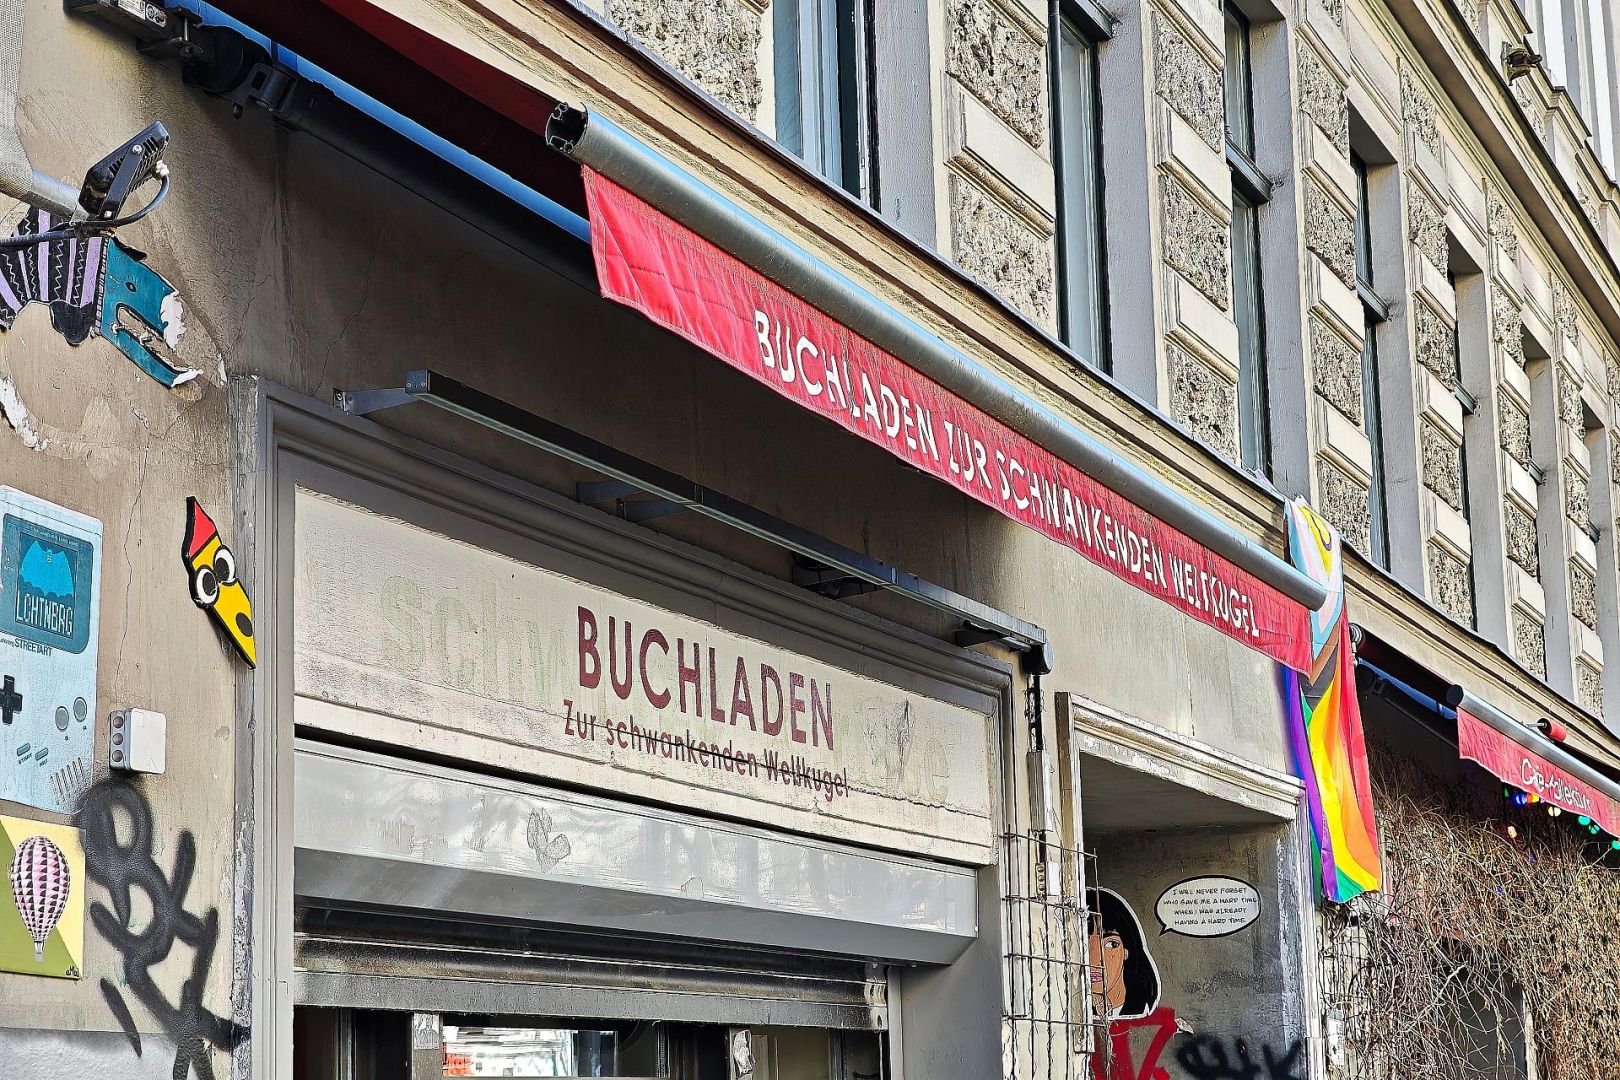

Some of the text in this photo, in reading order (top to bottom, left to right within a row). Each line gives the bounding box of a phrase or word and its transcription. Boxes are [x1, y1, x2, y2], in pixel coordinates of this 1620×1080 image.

[754, 309, 940, 462] BUCHLADEN
[943, 420, 993, 490] ZUR
[1168, 551, 1260, 637] WELTKUGEL
[14, 638, 52, 657] STREETART
[577, 605, 834, 751] BUCHLADEN
[563, 699, 596, 742] Zur
[605, 714, 758, 778] schwankenden
[764, 748, 850, 802] Weltkugel
[1196, 887, 1218, 895] NEVER
